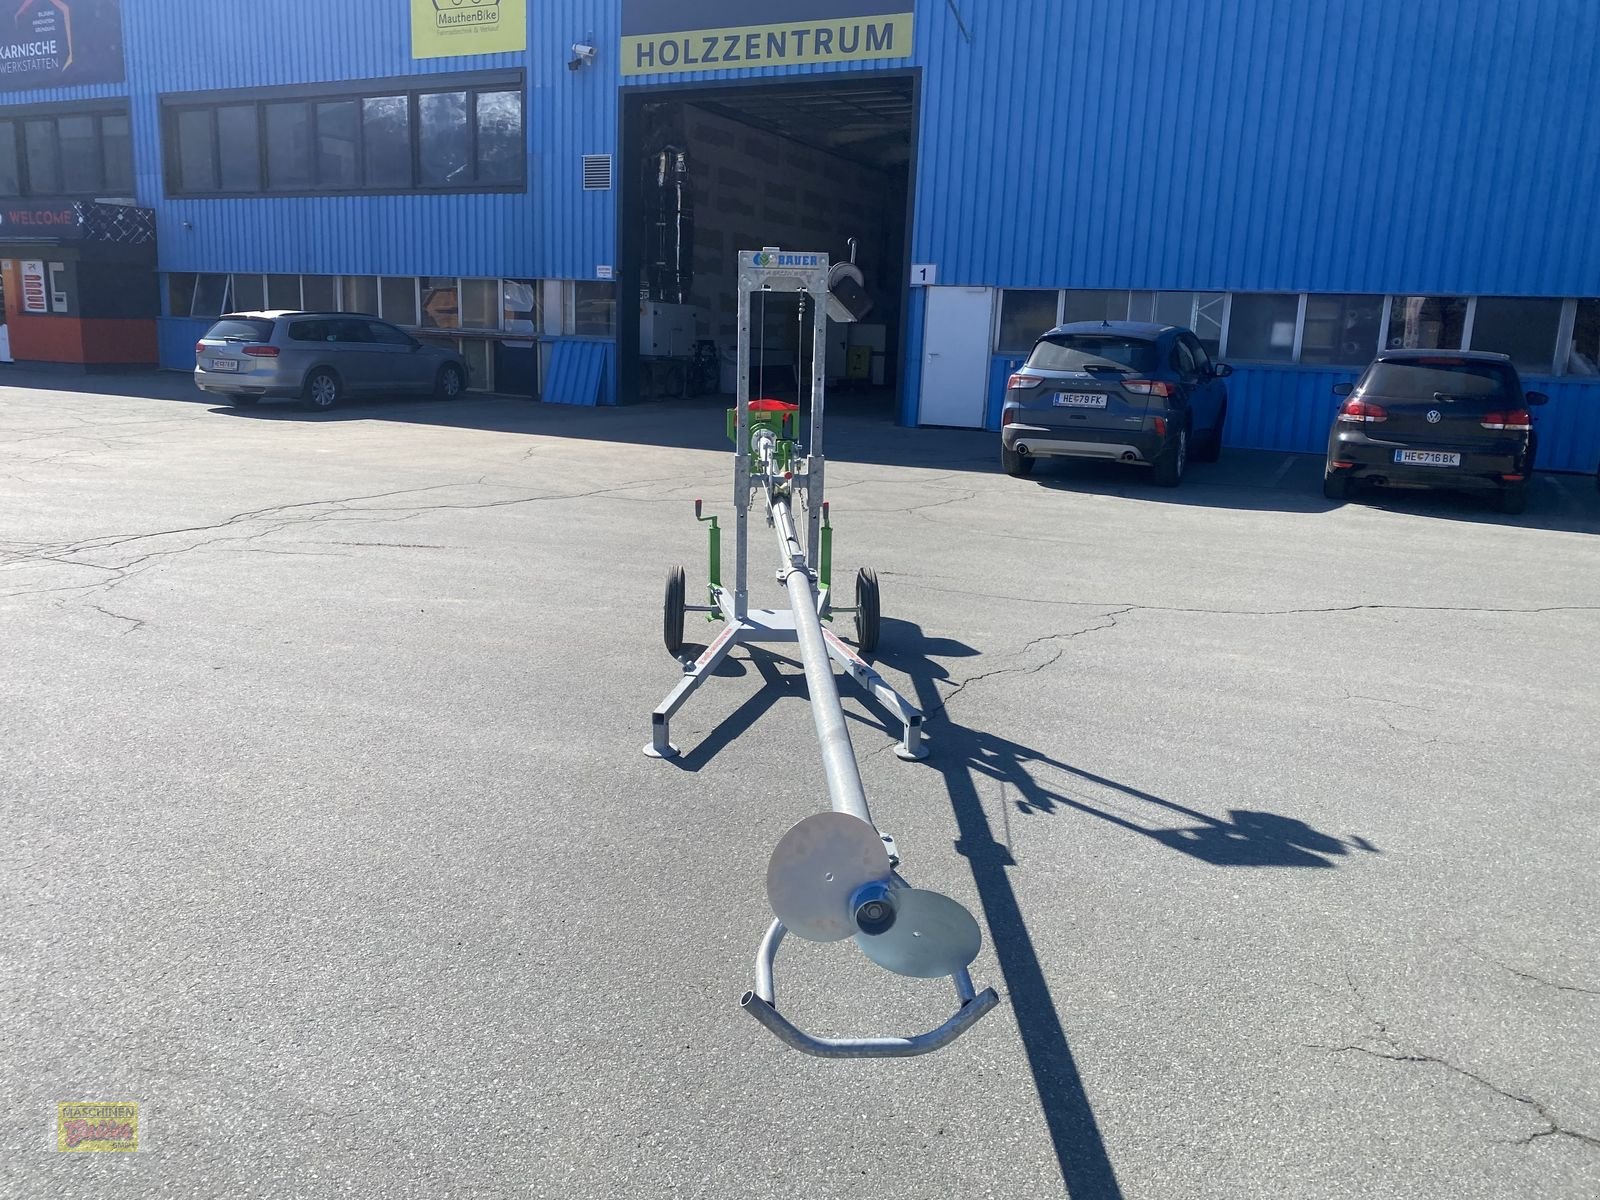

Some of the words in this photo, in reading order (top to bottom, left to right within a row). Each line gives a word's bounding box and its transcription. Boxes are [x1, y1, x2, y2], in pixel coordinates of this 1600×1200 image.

[438, 10, 496, 24] MauthenBike
[0, 40, 57, 59] KARNISCHE
[636, 23, 894, 67] HOLZZENTRUM
[9, 210, 72, 225] WELCOME
[778, 255, 817, 266] BAUER
[920, 268, 926, 281] 1
